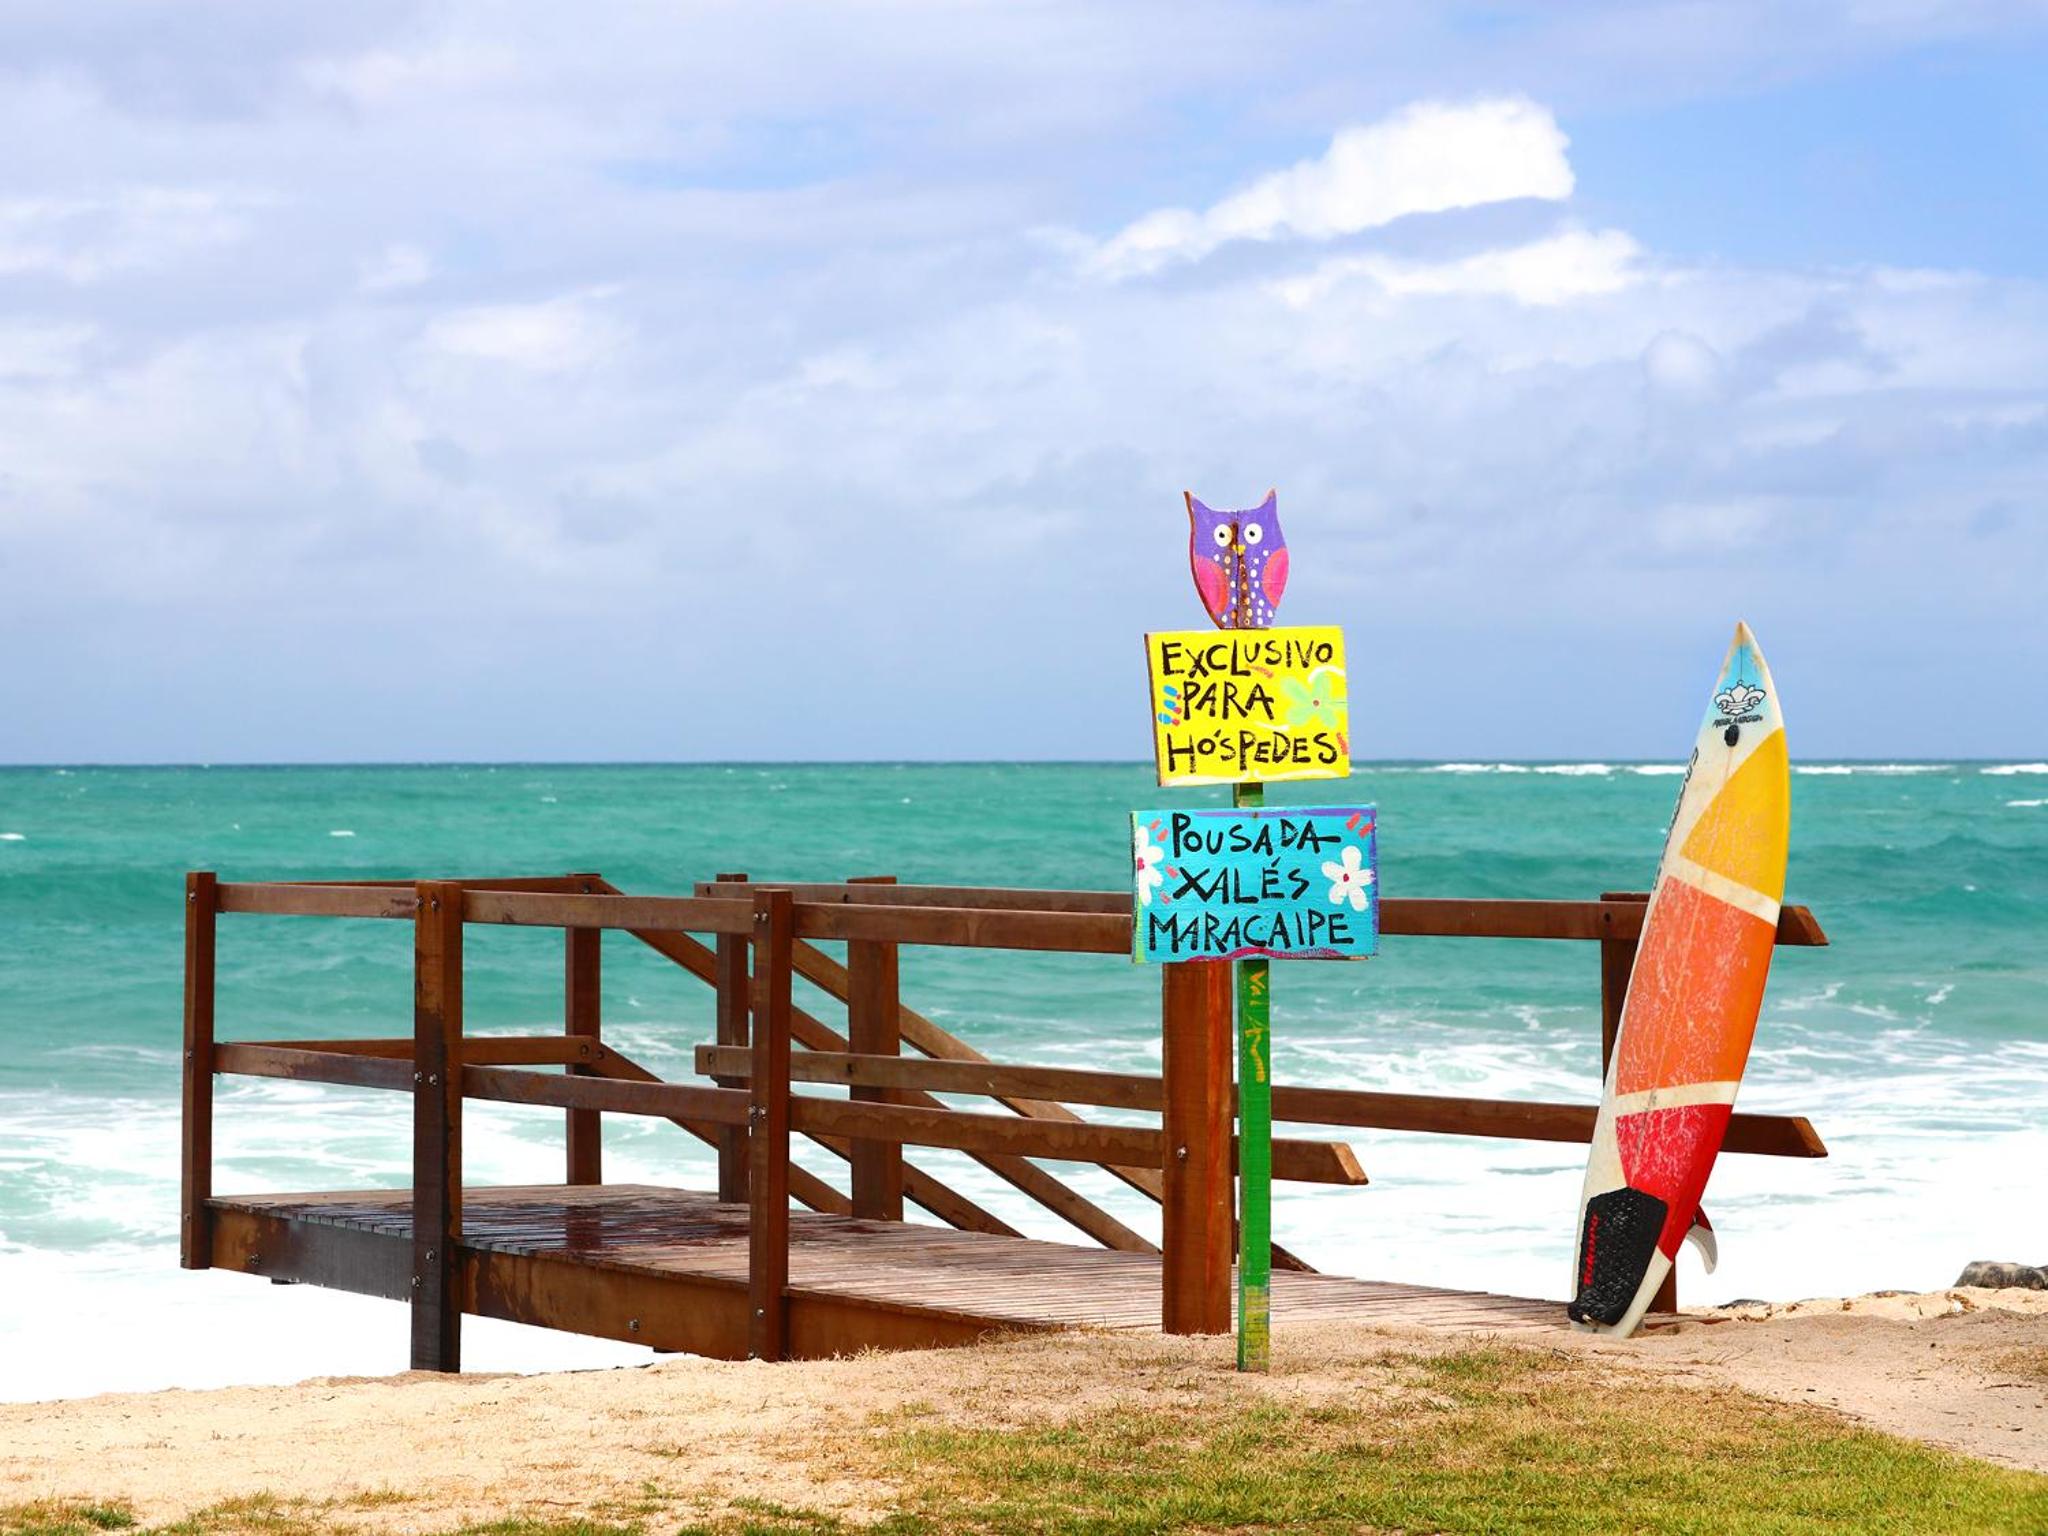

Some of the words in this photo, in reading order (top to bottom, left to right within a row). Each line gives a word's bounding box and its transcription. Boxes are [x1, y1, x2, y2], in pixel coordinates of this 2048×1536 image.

[1161, 640, 1334, 679] EXCLUSIVO
[1183, 681, 1275, 721] PARA
[1172, 812, 1342, 858] POUSADA
[1172, 857, 1310, 905] XALÉS
[1148, 908, 1355, 954] MARACAIPE
